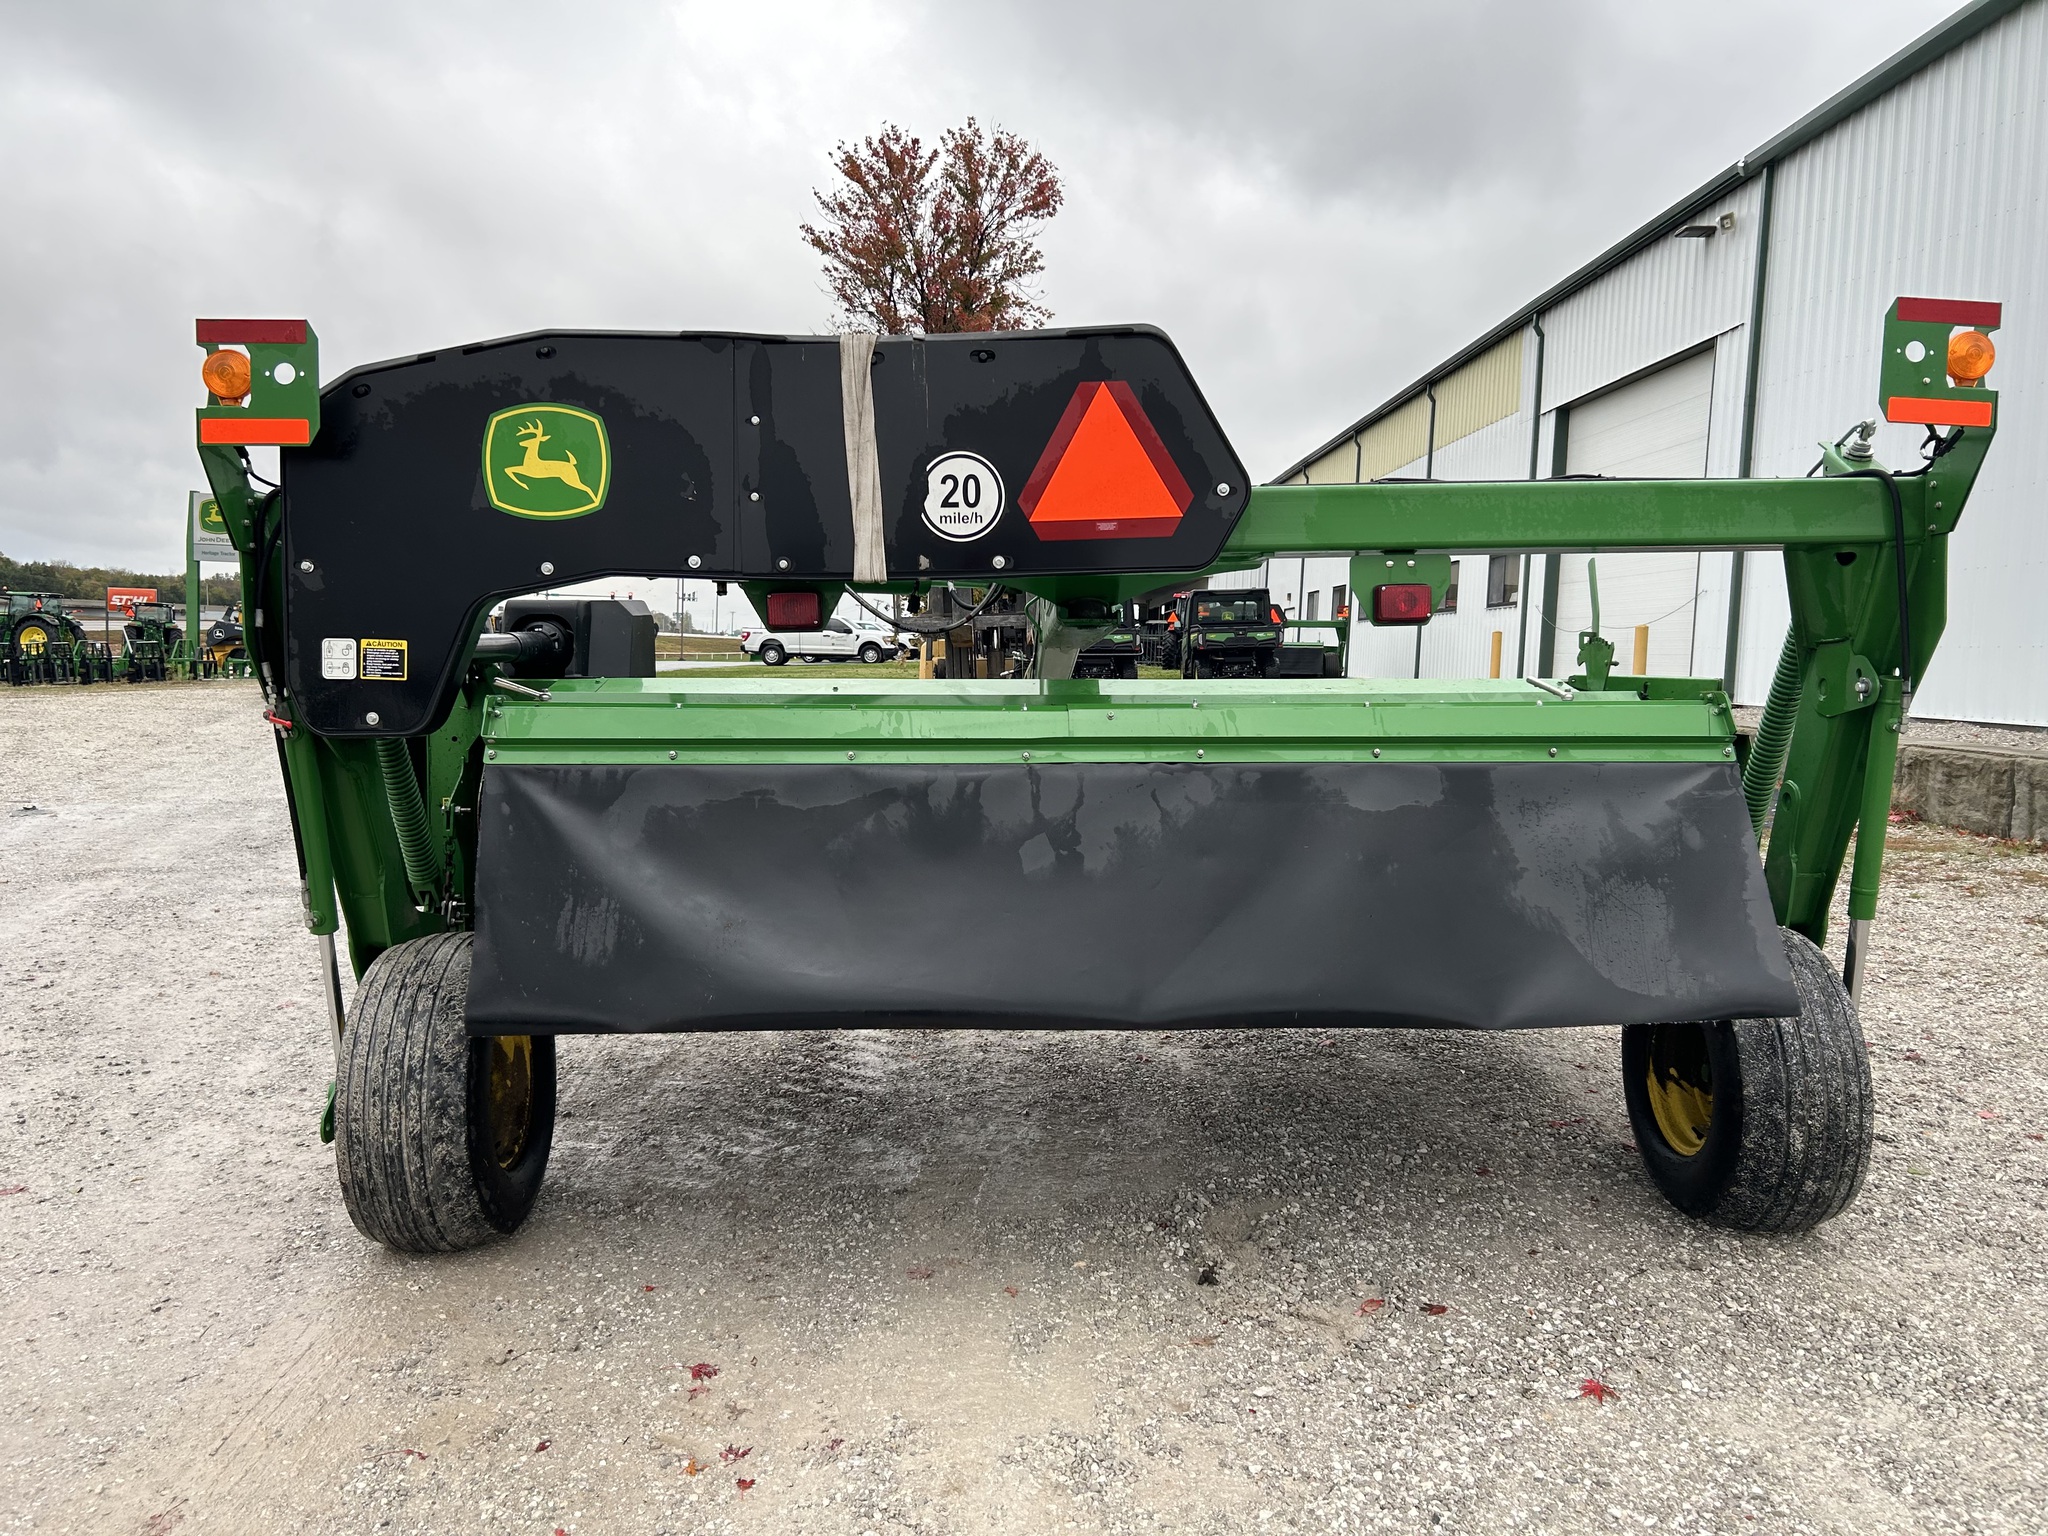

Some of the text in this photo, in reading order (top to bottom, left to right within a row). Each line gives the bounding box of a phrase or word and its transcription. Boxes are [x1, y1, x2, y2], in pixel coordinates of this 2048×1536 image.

[940, 473, 982, 509] 20
[939, 511, 983, 524] mile/h
[110, 595, 149, 606] STIHL
[371, 640, 403, 648] CAUTION
